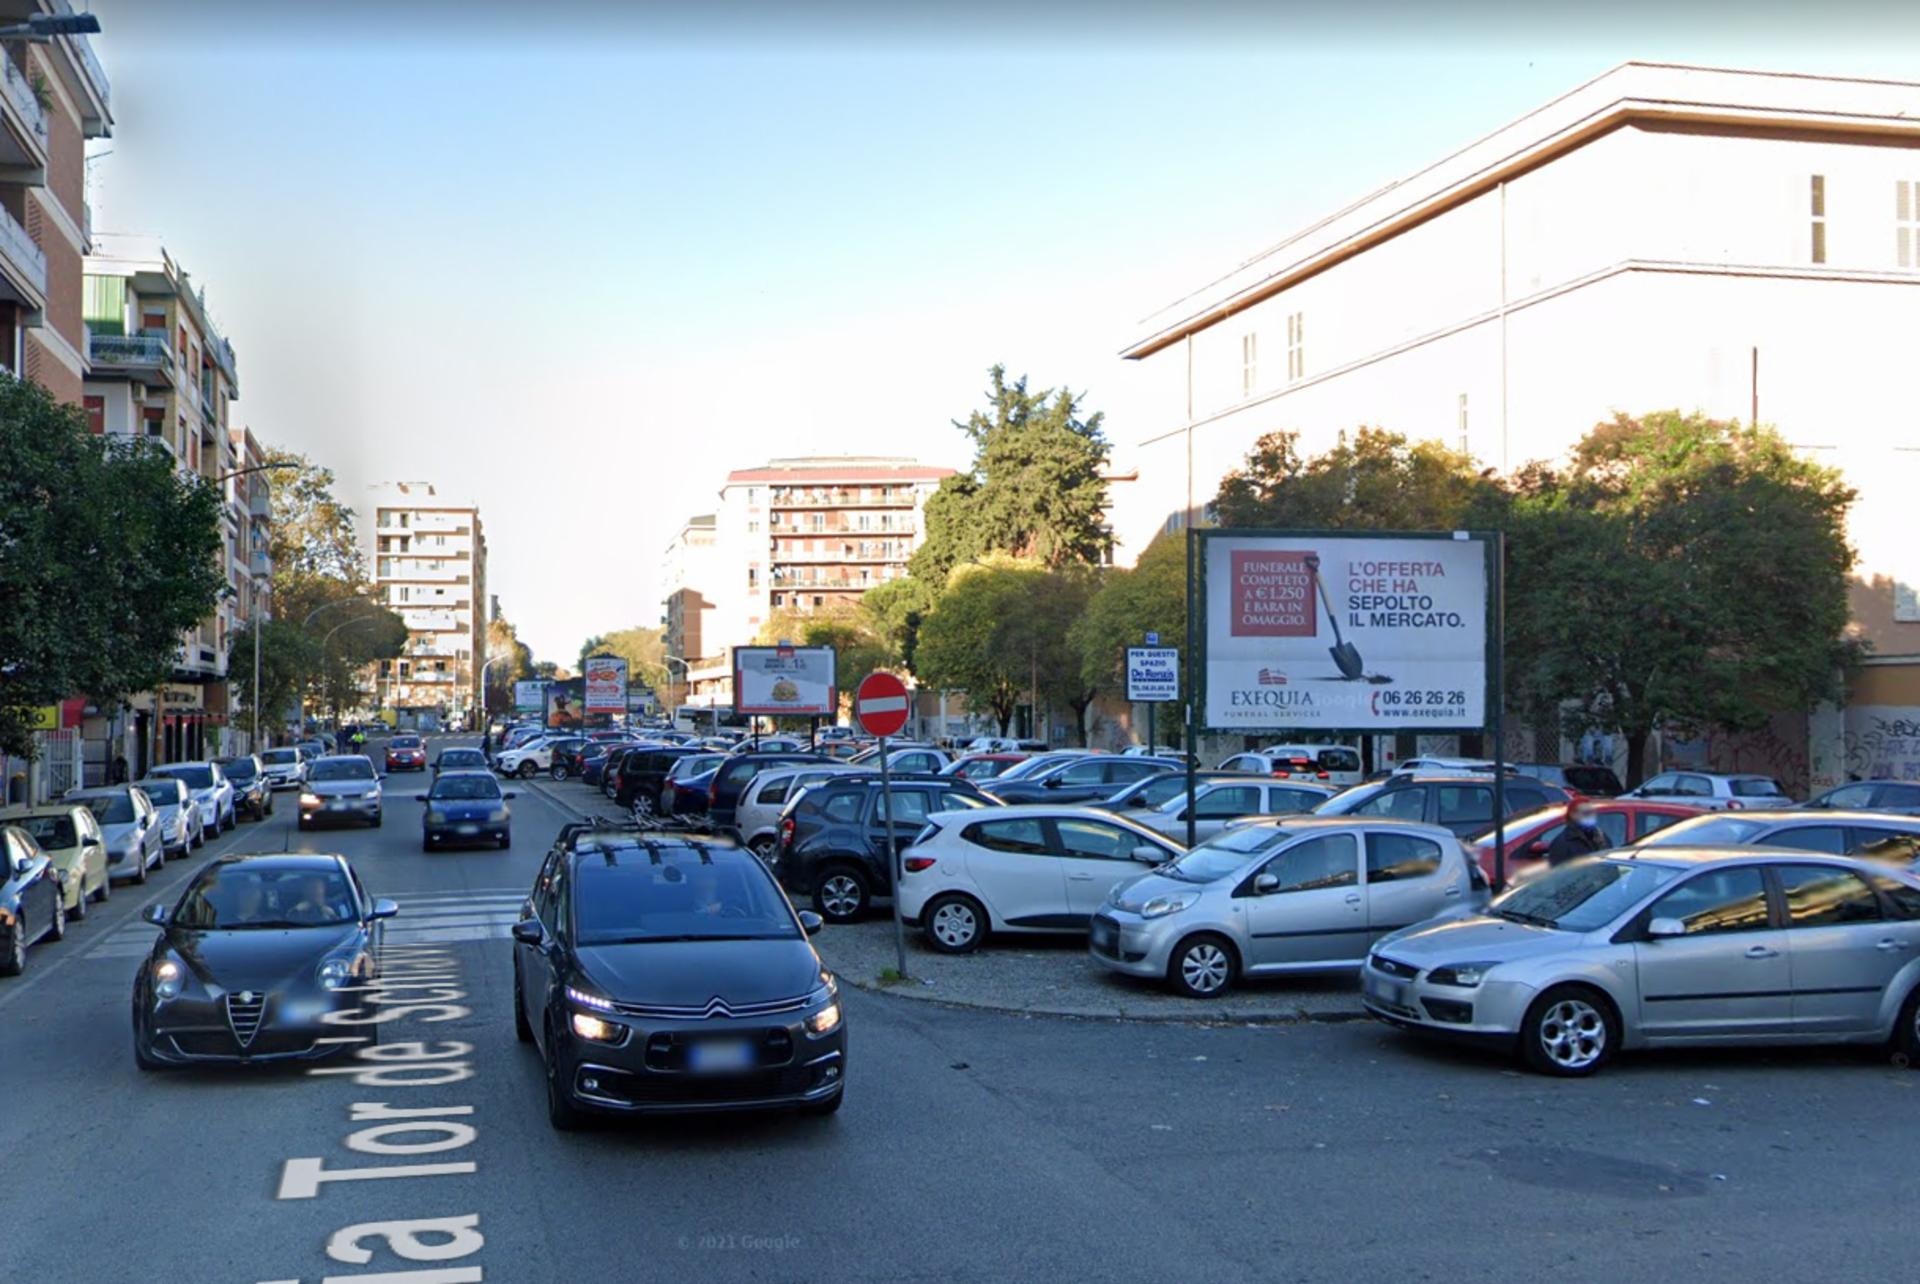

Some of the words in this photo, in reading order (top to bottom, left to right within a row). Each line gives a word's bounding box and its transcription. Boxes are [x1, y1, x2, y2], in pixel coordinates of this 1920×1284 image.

[1243, 561, 1304, 573] FUNERALE
[1349, 561, 1446, 577] L'OFFERTA
[1240, 574, 1310, 586] COMPLETO
[1348, 578, 1388, 594] CHE
[1392, 578, 1419, 594] HA
[1243, 601, 1250, 613] E
[1254, 601, 1286, 613] BARA
[1288, 601, 1303, 613] IN
[1348, 594, 1433, 611] SEPOLTO
[1348, 612, 1366, 628] IL
[1370, 612, 1466, 628] MERCATO.
[1231, 689, 1314, 710] EXEQUIA
[1382, 690, 1401, 705] 06
[1404, 690, 1422, 705] 26
[1426, 690, 1444, 705] 26
[1447, 690, 1466, 705] 26
[1223, 710, 1269, 718] FUNERAL
[1273, 710, 1321, 718] SERVICES
[1382, 706, 1466, 719] www.exequia.it
